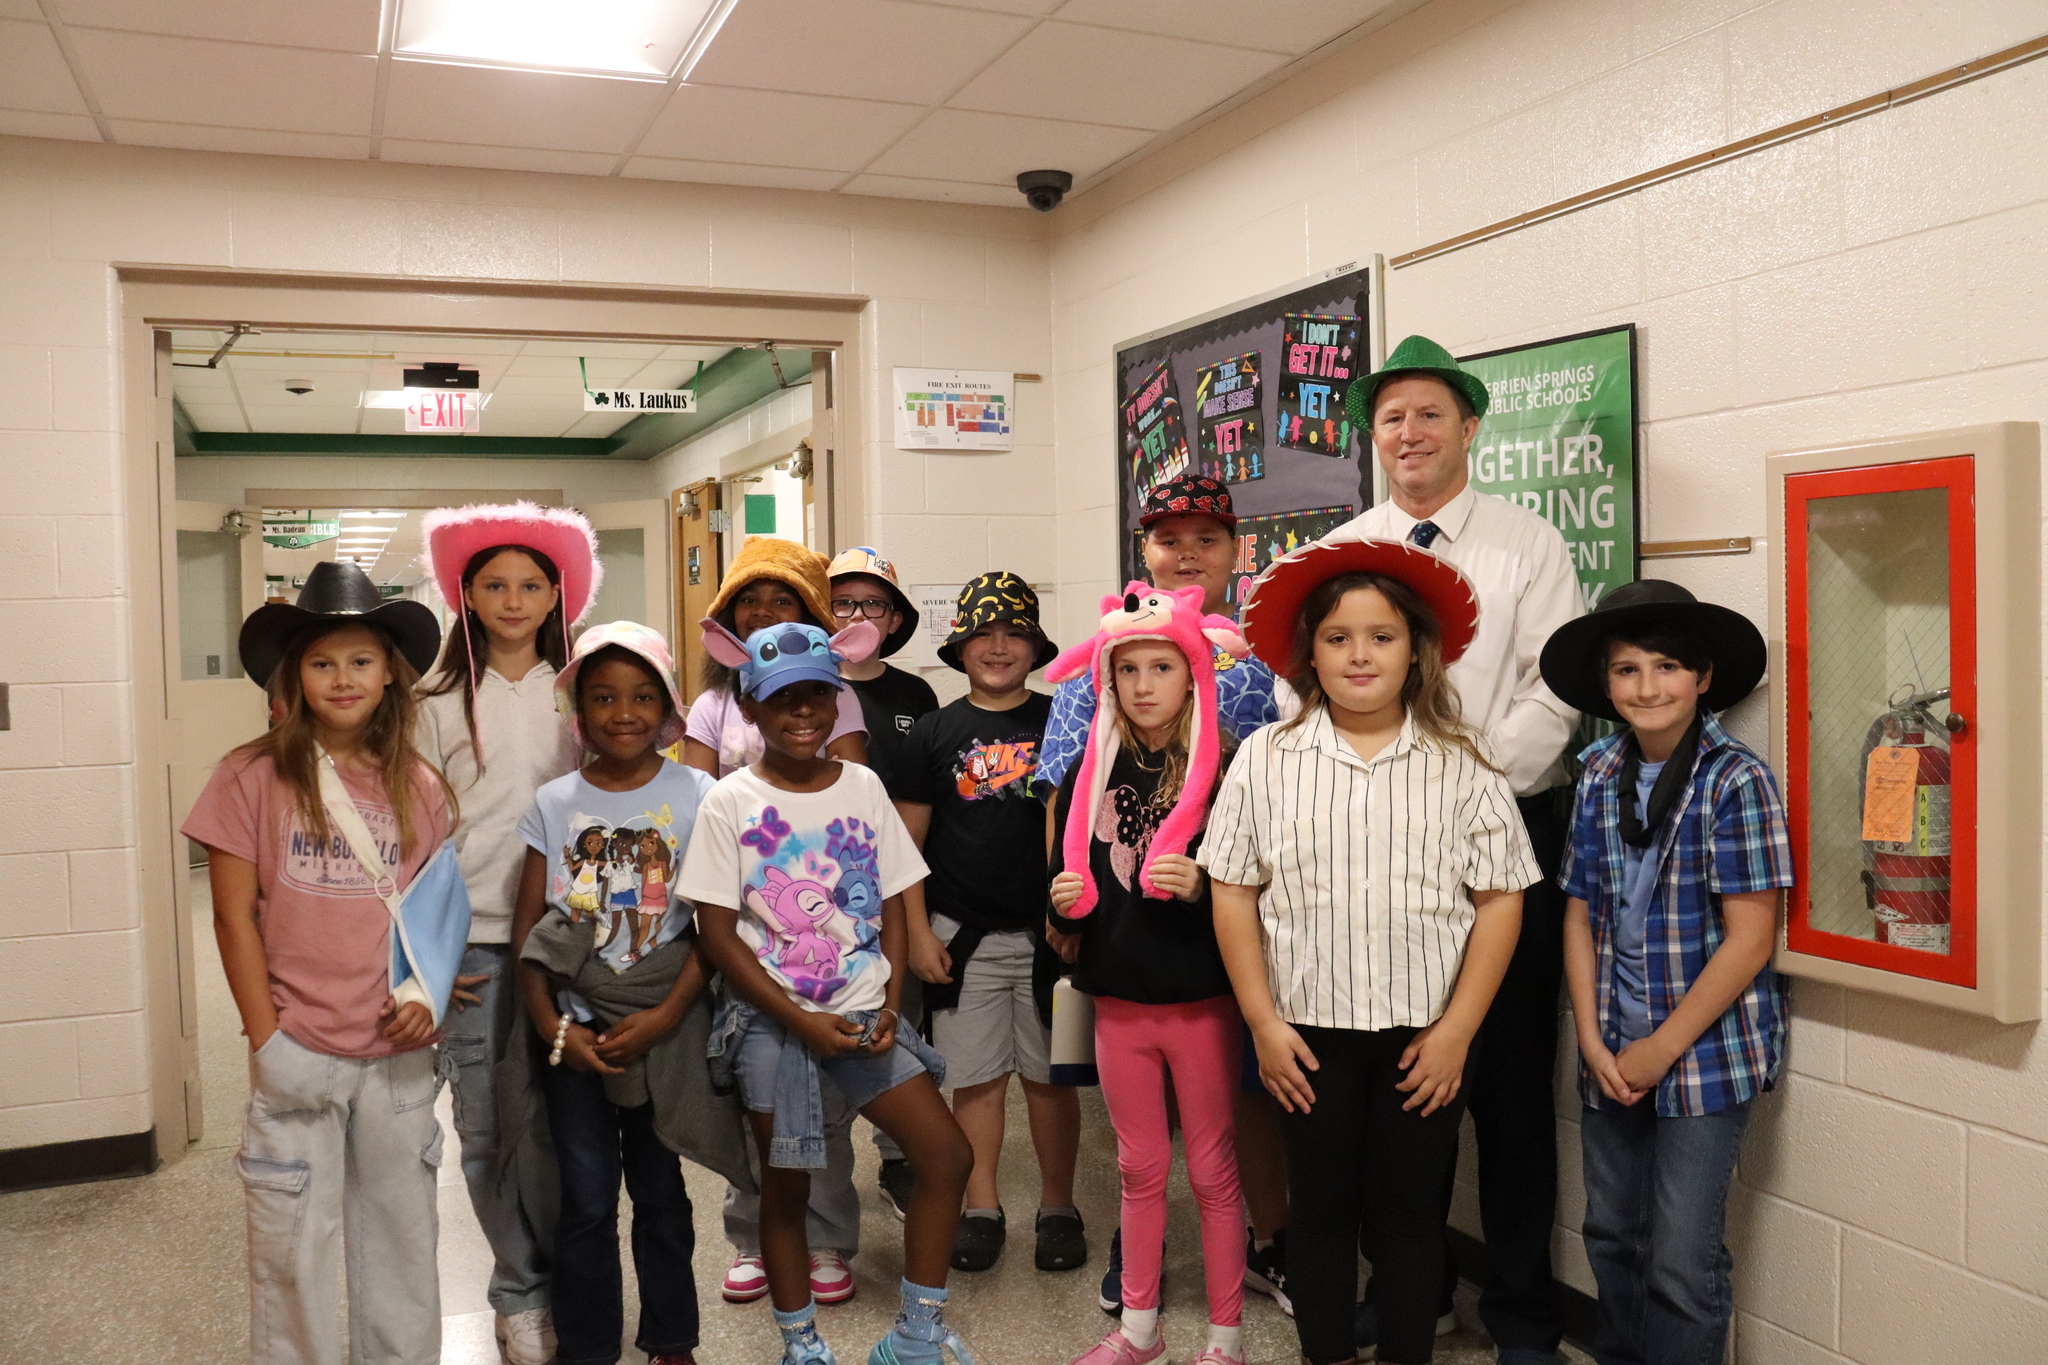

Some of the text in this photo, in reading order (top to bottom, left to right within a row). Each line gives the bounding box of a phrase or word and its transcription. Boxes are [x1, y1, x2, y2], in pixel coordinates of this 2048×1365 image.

[1302, 320, 1340, 346] I DON'T
[1219, 362, 1237, 380] THIS
[1288, 343, 1349, 379] GET IT...
[1214, 374, 1243, 396] DOESN'T
[1486, 364, 1595, 398] ERRIEN SPRINGS
[420, 393, 467, 429] EXIT
[614, 391, 687, 409] Ms. Laukus
[1126, 368, 1169, 427] IT DOESN'T
[1203, 387, 1254, 418] MAKE SENSE
[1298, 382, 1331, 420] YET
[1485, 385, 1592, 416] UBLIC SCHOOLS
[1141, 420, 1167, 464] YET
[1214, 419, 1243, 455] YET
[1468, 434, 1614, 484] GETHER,
[272, 526, 282, 534] Ms.
[1565, 540, 1615, 571] ENT
[1582, 582, 1606, 615] K
[1920, 793, 1926, 803] A
[363, 811, 394, 827] OAST
[1920, 816, 1926, 826] B
[291, 831, 326, 858] NEW
[1920, 839, 1926, 849] C
[300, 860, 364, 873] MICHIG
